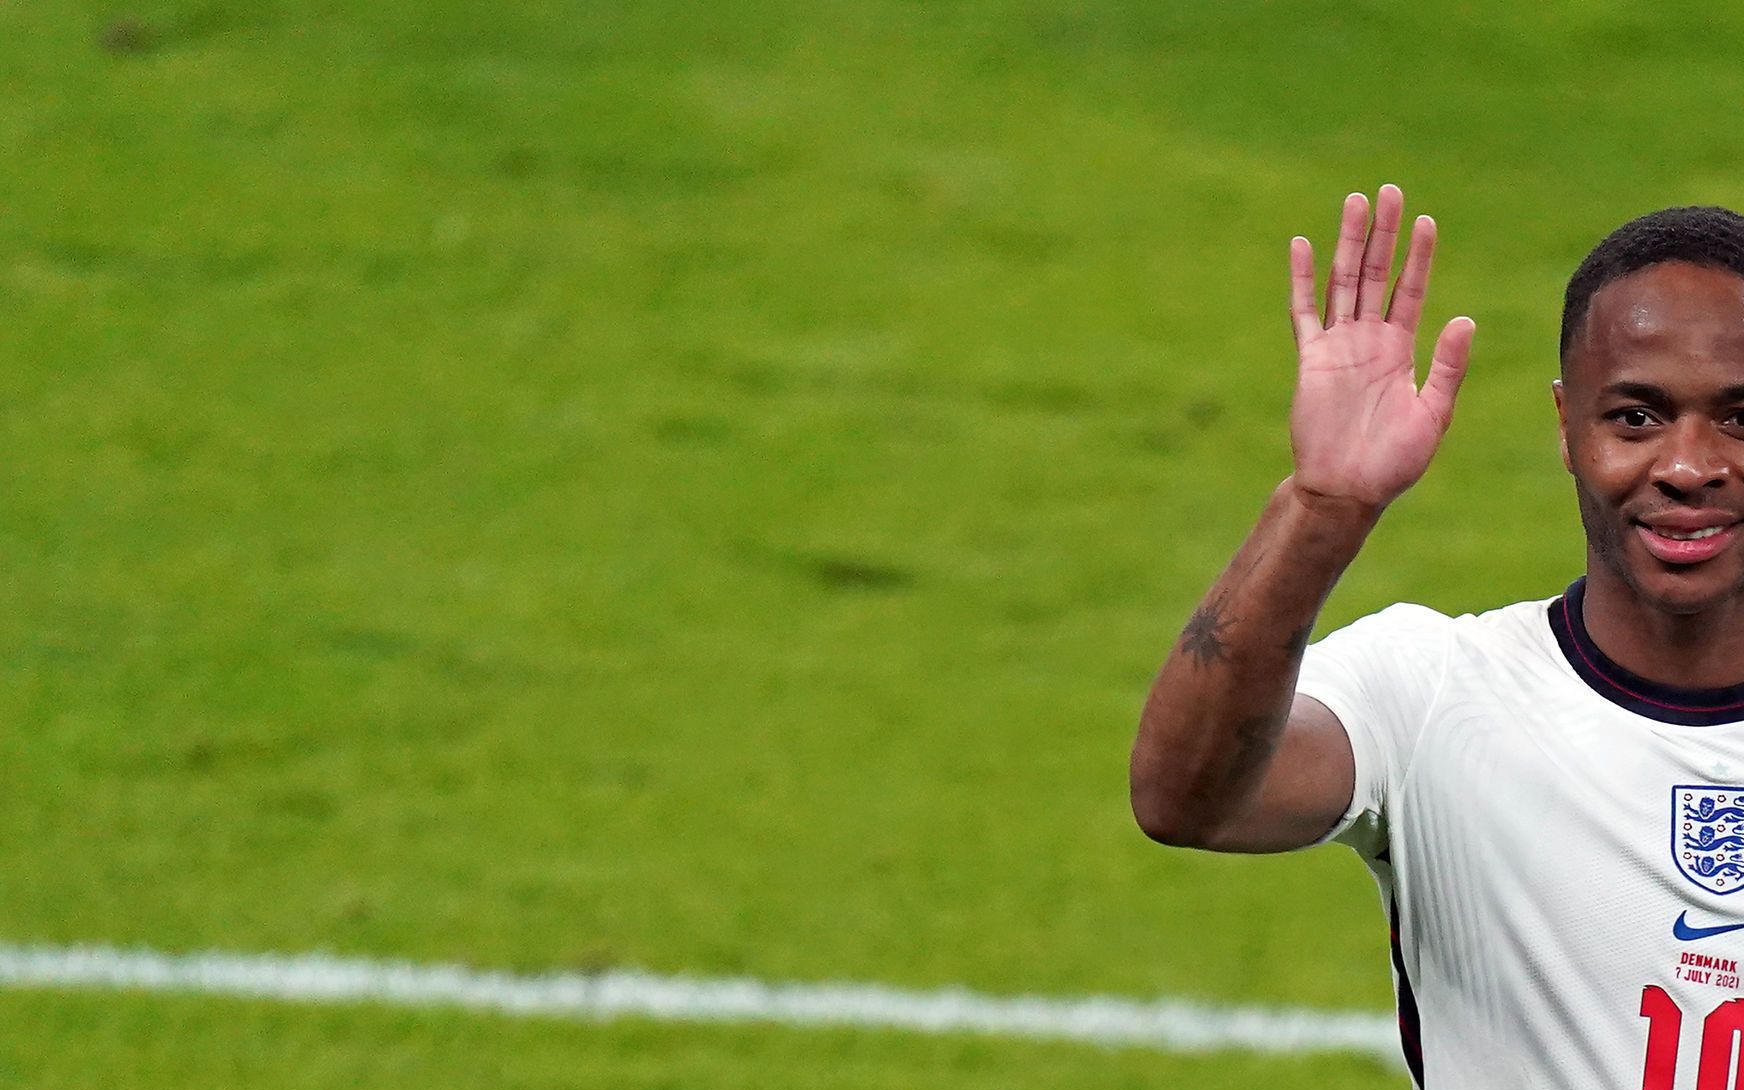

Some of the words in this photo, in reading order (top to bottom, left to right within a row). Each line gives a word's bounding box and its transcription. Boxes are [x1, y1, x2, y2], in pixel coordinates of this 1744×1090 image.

[1681, 952, 1737, 973] DENMARK
[1675, 967, 1681, 978] 7
[1684, 970, 1711, 984] JULY
[1716, 974, 1739, 988] 2021
